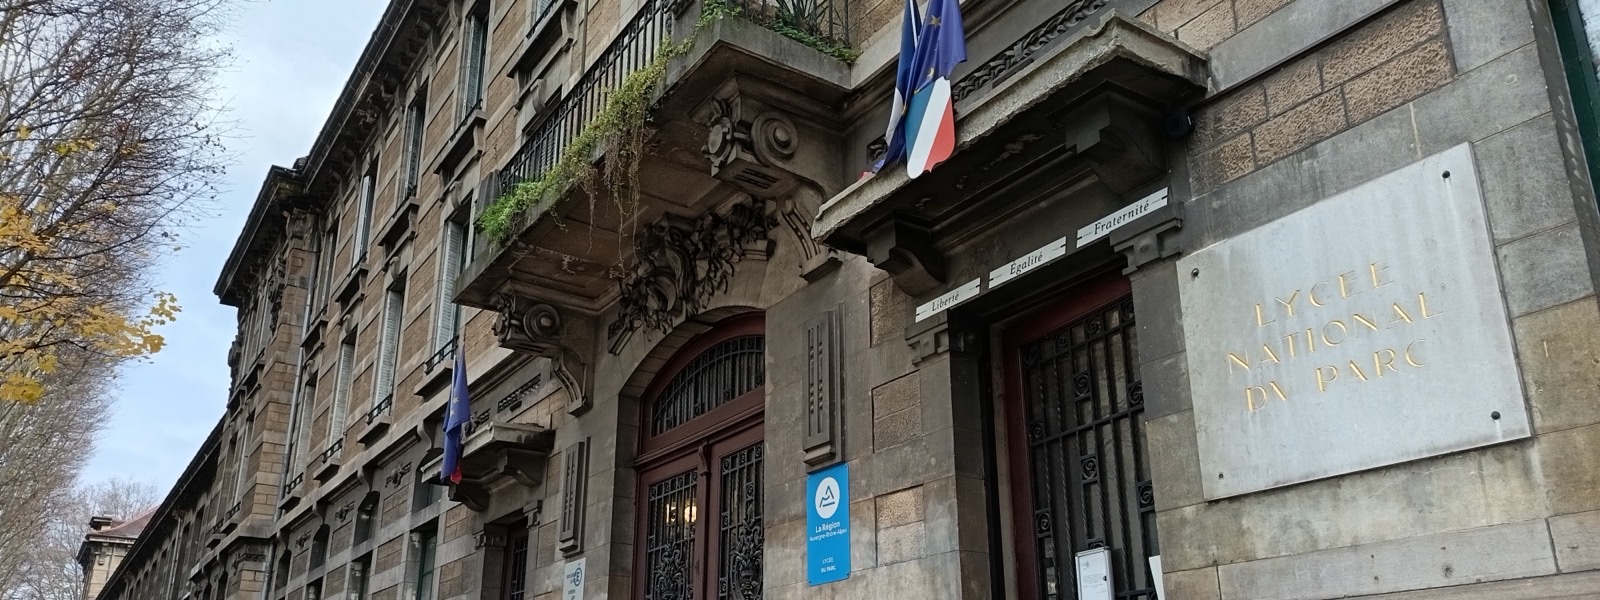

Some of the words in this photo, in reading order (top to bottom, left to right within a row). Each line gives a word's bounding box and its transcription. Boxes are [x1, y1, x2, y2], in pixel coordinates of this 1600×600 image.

[1094, 199, 1150, 236] Fraternité
[1009, 251, 1044, 276] Égalité
[931, 291, 960, 312] Liberté
[1255, 258, 1395, 327] LYCEE
[1227, 291, 1444, 376] NATIONAL
[1316, 338, 1429, 393] PARC
[822, 521, 840, 531] Région
